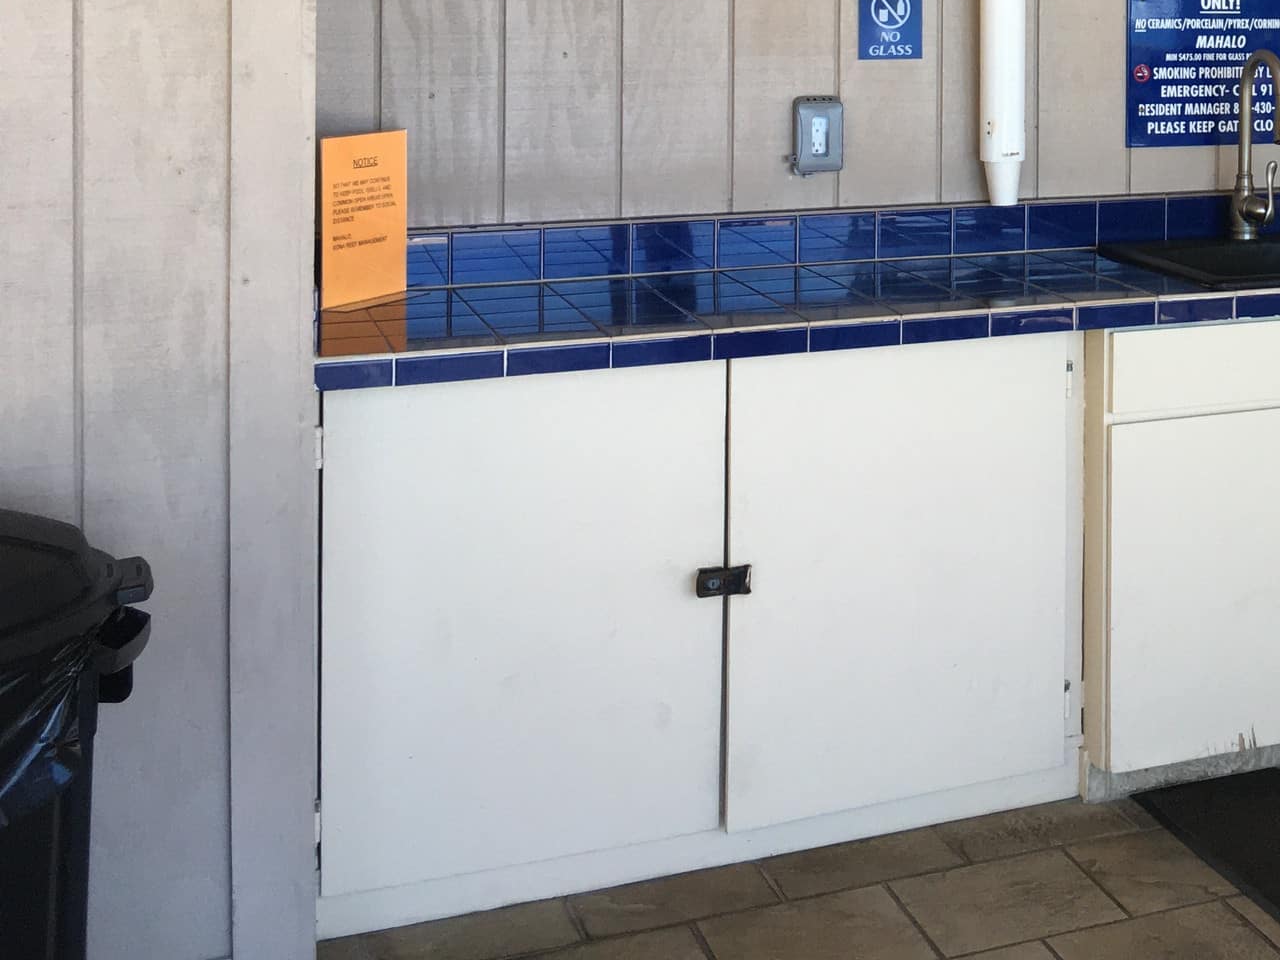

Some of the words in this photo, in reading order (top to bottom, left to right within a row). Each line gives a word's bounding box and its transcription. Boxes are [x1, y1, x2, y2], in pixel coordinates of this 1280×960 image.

[1135, 18, 1146, 29] NO
[880, 31, 900, 43] NO
[1195, 35, 1247, 49] MAHALO
[869, 44, 913, 56] GLASS
[1203, 52, 1215, 61] FINE
[1215, 52, 1227, 61] FOR
[1228, 52, 1245, 61] GLASS
[1153, 66, 1197, 80] SMOKING
[1198, 66, 1244, 79] PROHIBIT
[1161, 85, 1229, 98] EMERGENCY-
[1232, 84, 1257, 96] CL
[1260, 84, 1273, 96] 91
[1138, 103, 1182, 116] RESIDENT
[1184, 102, 1230, 116] MANAGER
[1147, 121, 1186, 135] PLEASE
[1189, 120, 1215, 134] KEEP
[1218, 120, 1239, 133] GAT
[1254, 119, 1274, 132] CLO
[352, 156, 378, 168] NOTICE
